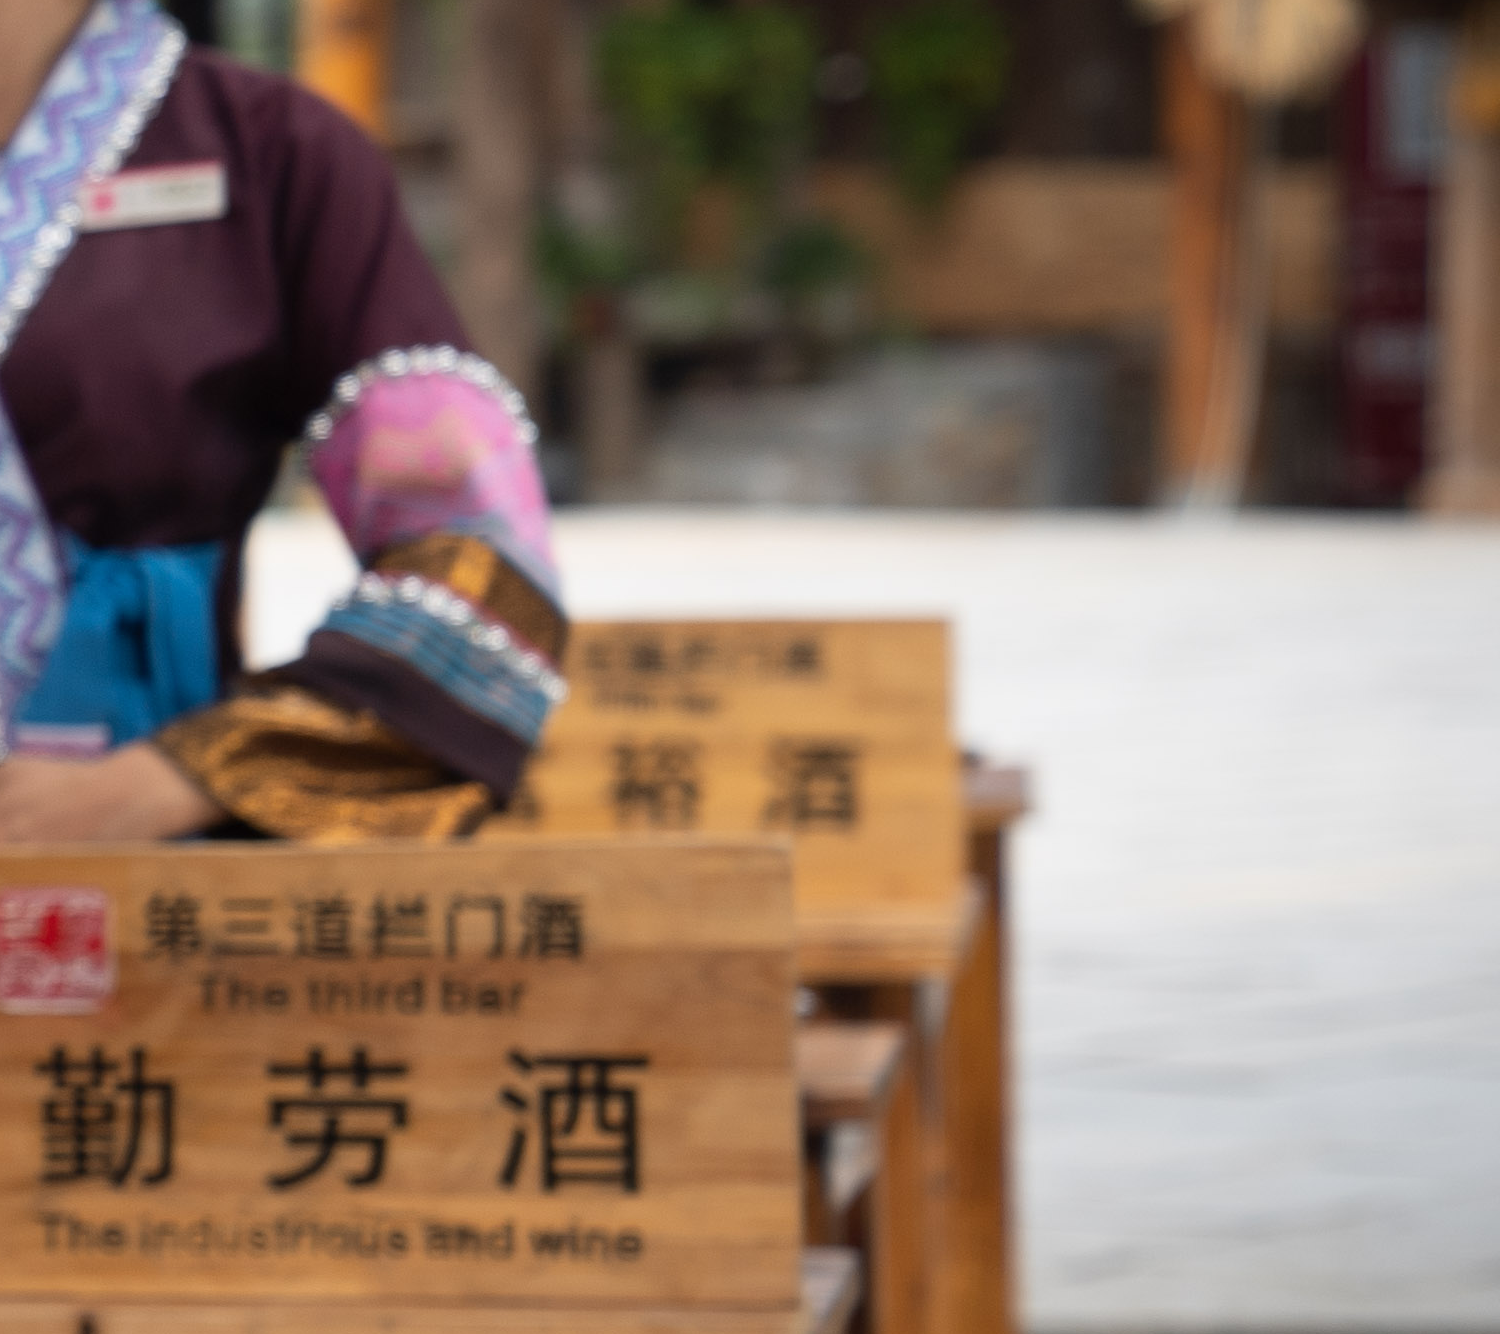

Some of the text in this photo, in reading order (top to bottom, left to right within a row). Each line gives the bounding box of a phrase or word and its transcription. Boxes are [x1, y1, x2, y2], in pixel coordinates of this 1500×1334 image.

[143, 893, 584, 964] 第三道拦门酒
[199, 972, 525, 1016] The third bar
[34, 1046, 650, 1194] 勤劳酒
[36, 1212, 125, 1255] The
[423, 1219, 516, 1260] and
[528, 1221, 646, 1263] wine
